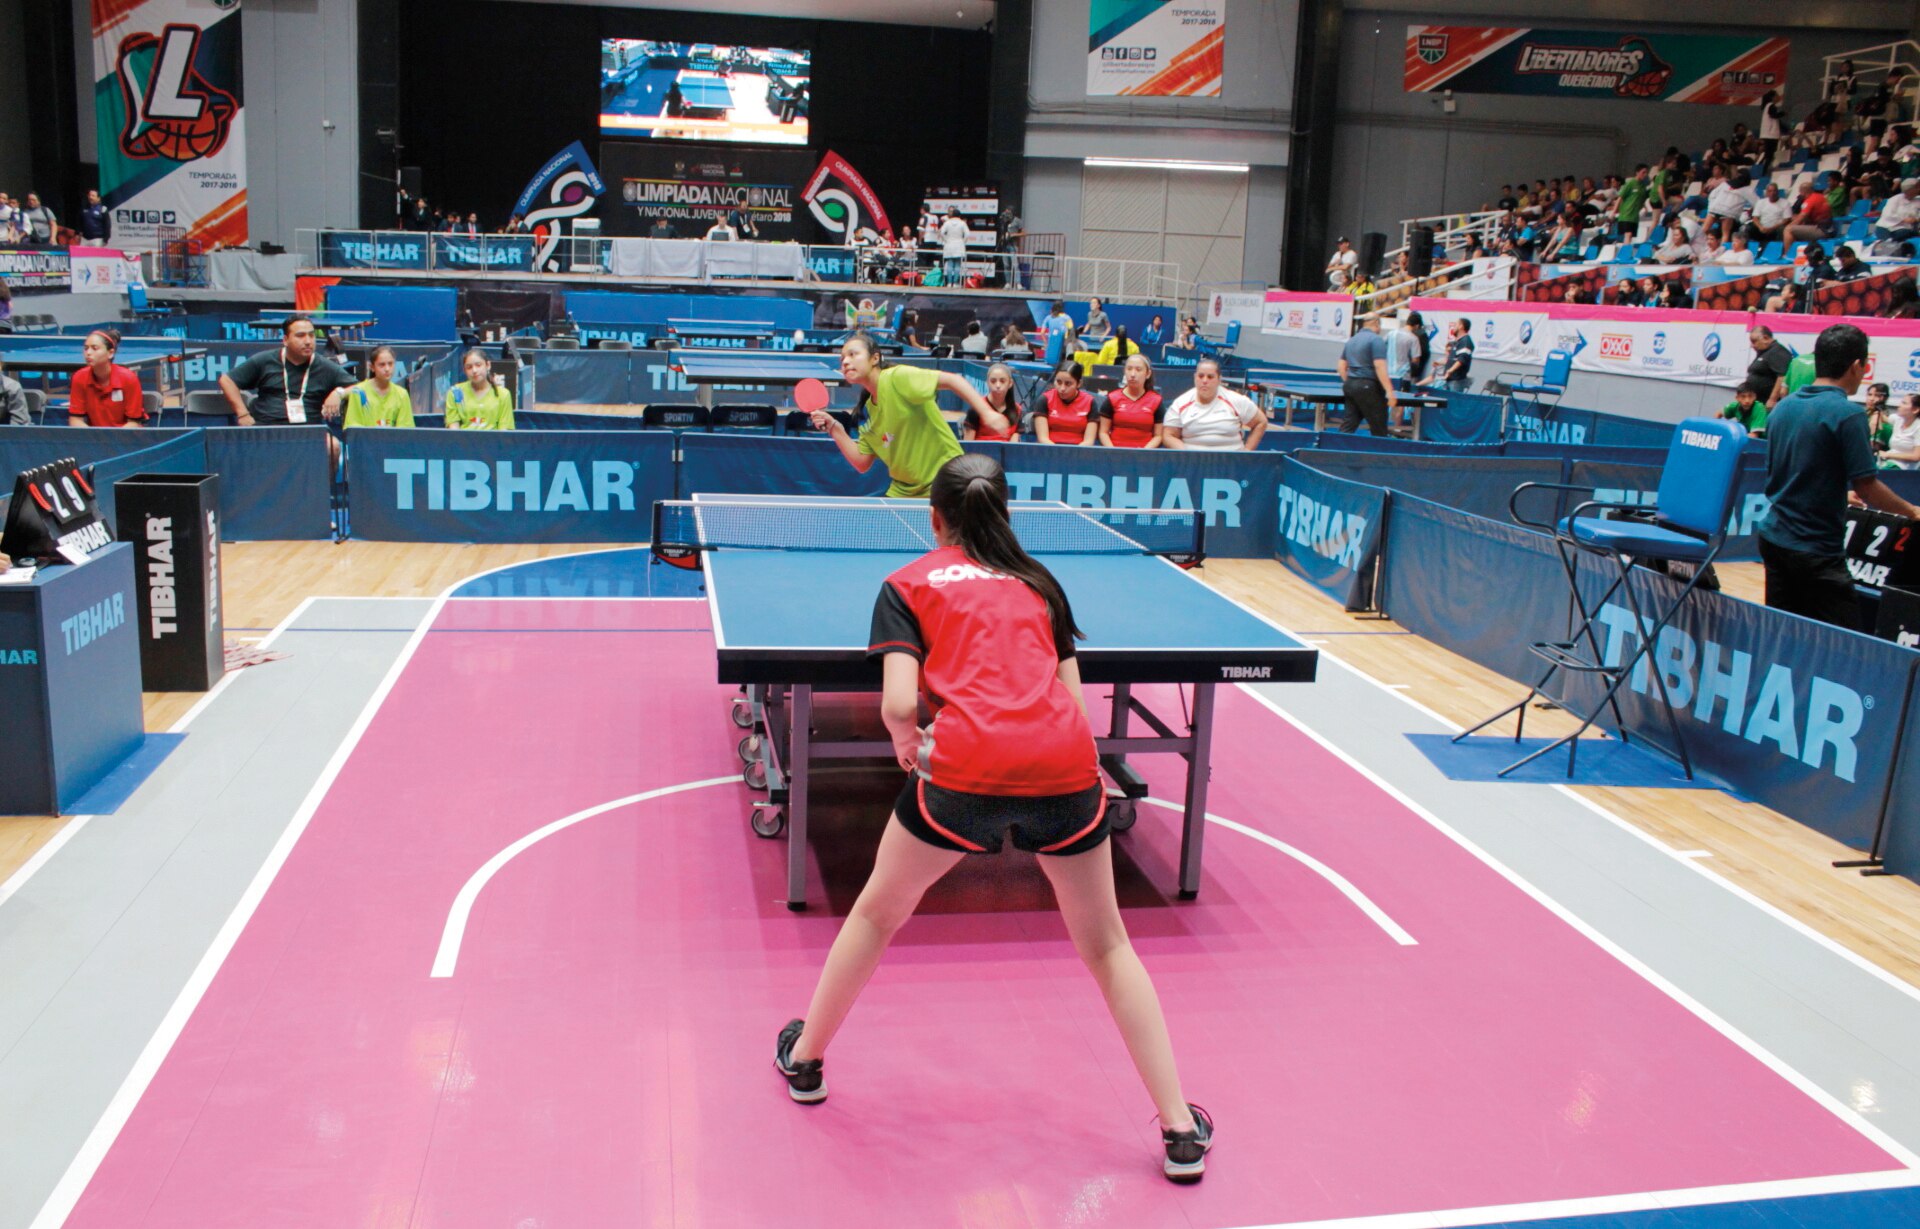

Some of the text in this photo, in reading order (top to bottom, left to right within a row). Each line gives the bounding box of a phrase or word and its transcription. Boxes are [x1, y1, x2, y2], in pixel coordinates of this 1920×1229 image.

[188, 171, 237, 180] TEMPORADA
[200, 181, 238, 189] 2017-2018
[637, 206, 644, 216] Y
[644, 207, 692, 219] NACIONAL
[341, 242, 420, 260] TIBHAR
[1600, 336, 1632, 356] OXXO
[1681, 429, 1721, 450] TIBHAR
[384, 459, 636, 511] TIBHAR
[1279, 483, 1368, 571] TIBHAR
[1865, 525, 1889, 557] 2
[146, 516, 178, 639] TIBHAR
[61, 592, 125, 656] TIBHAR
[1221, 666, 1271, 678] TIBHAR
[1598, 603, 1865, 783] TIBHAR
